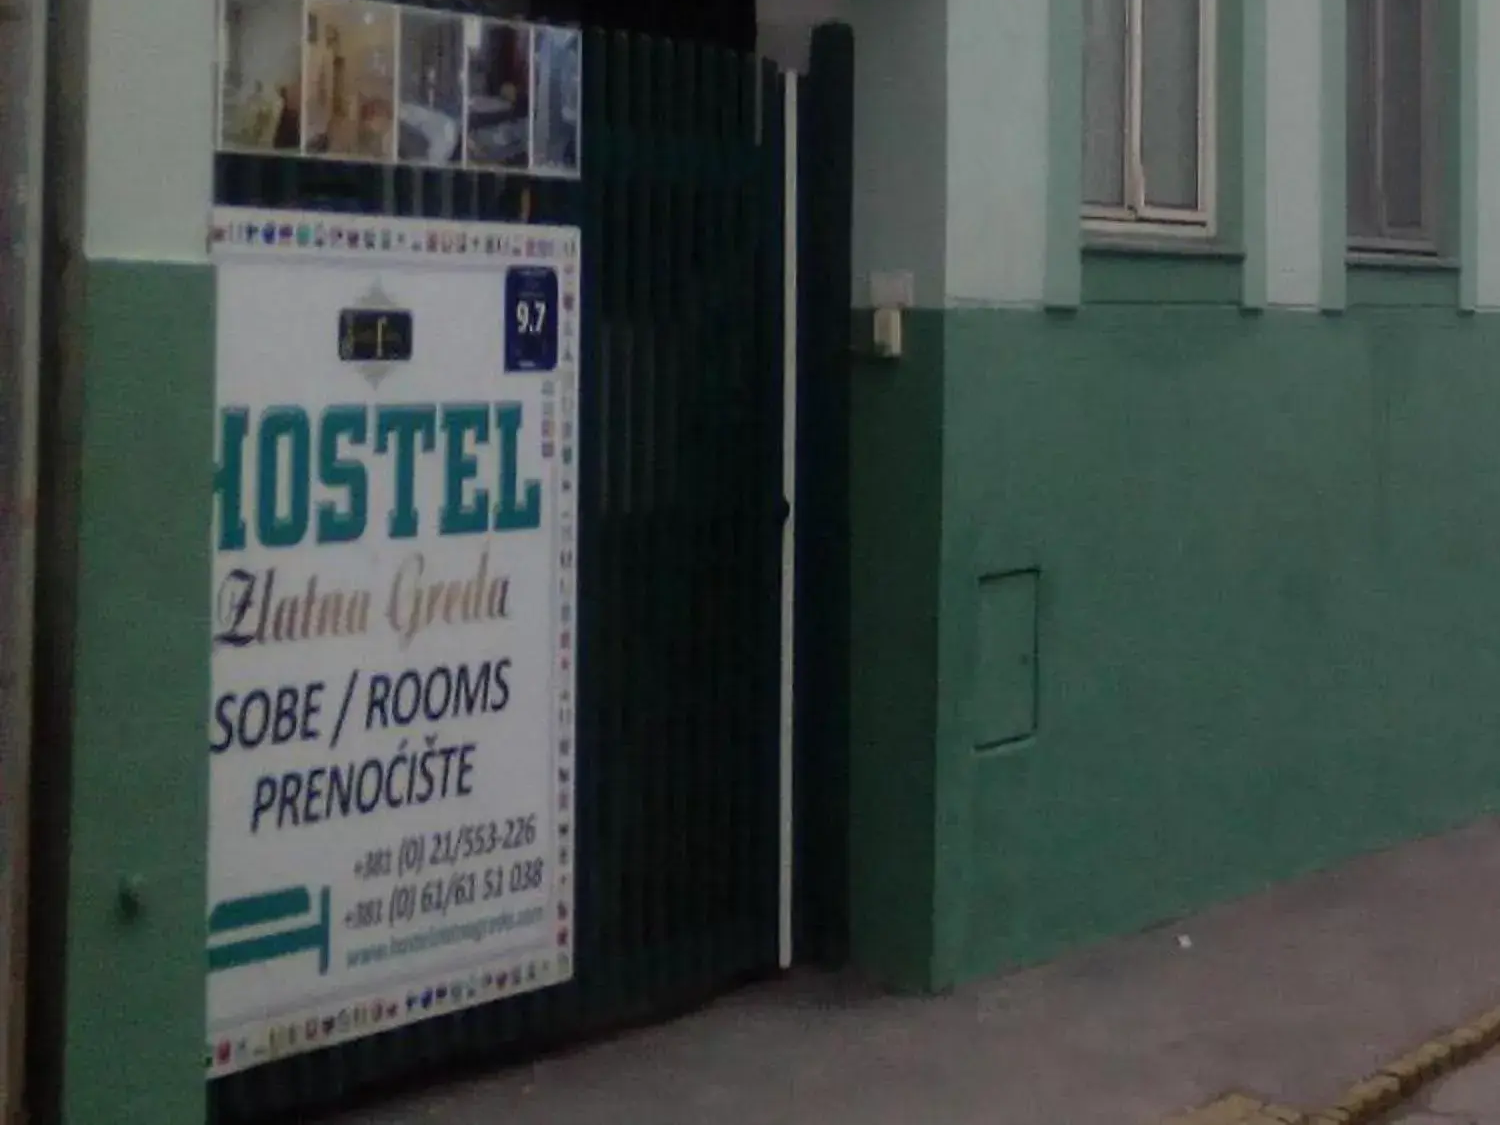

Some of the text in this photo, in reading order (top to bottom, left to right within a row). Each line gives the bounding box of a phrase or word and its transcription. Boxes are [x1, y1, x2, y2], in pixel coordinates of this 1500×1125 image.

[516, 300, 546, 333] 9.7
[210, 682, 326, 754] SOBE
[365, 657, 513, 730] ROOMS
